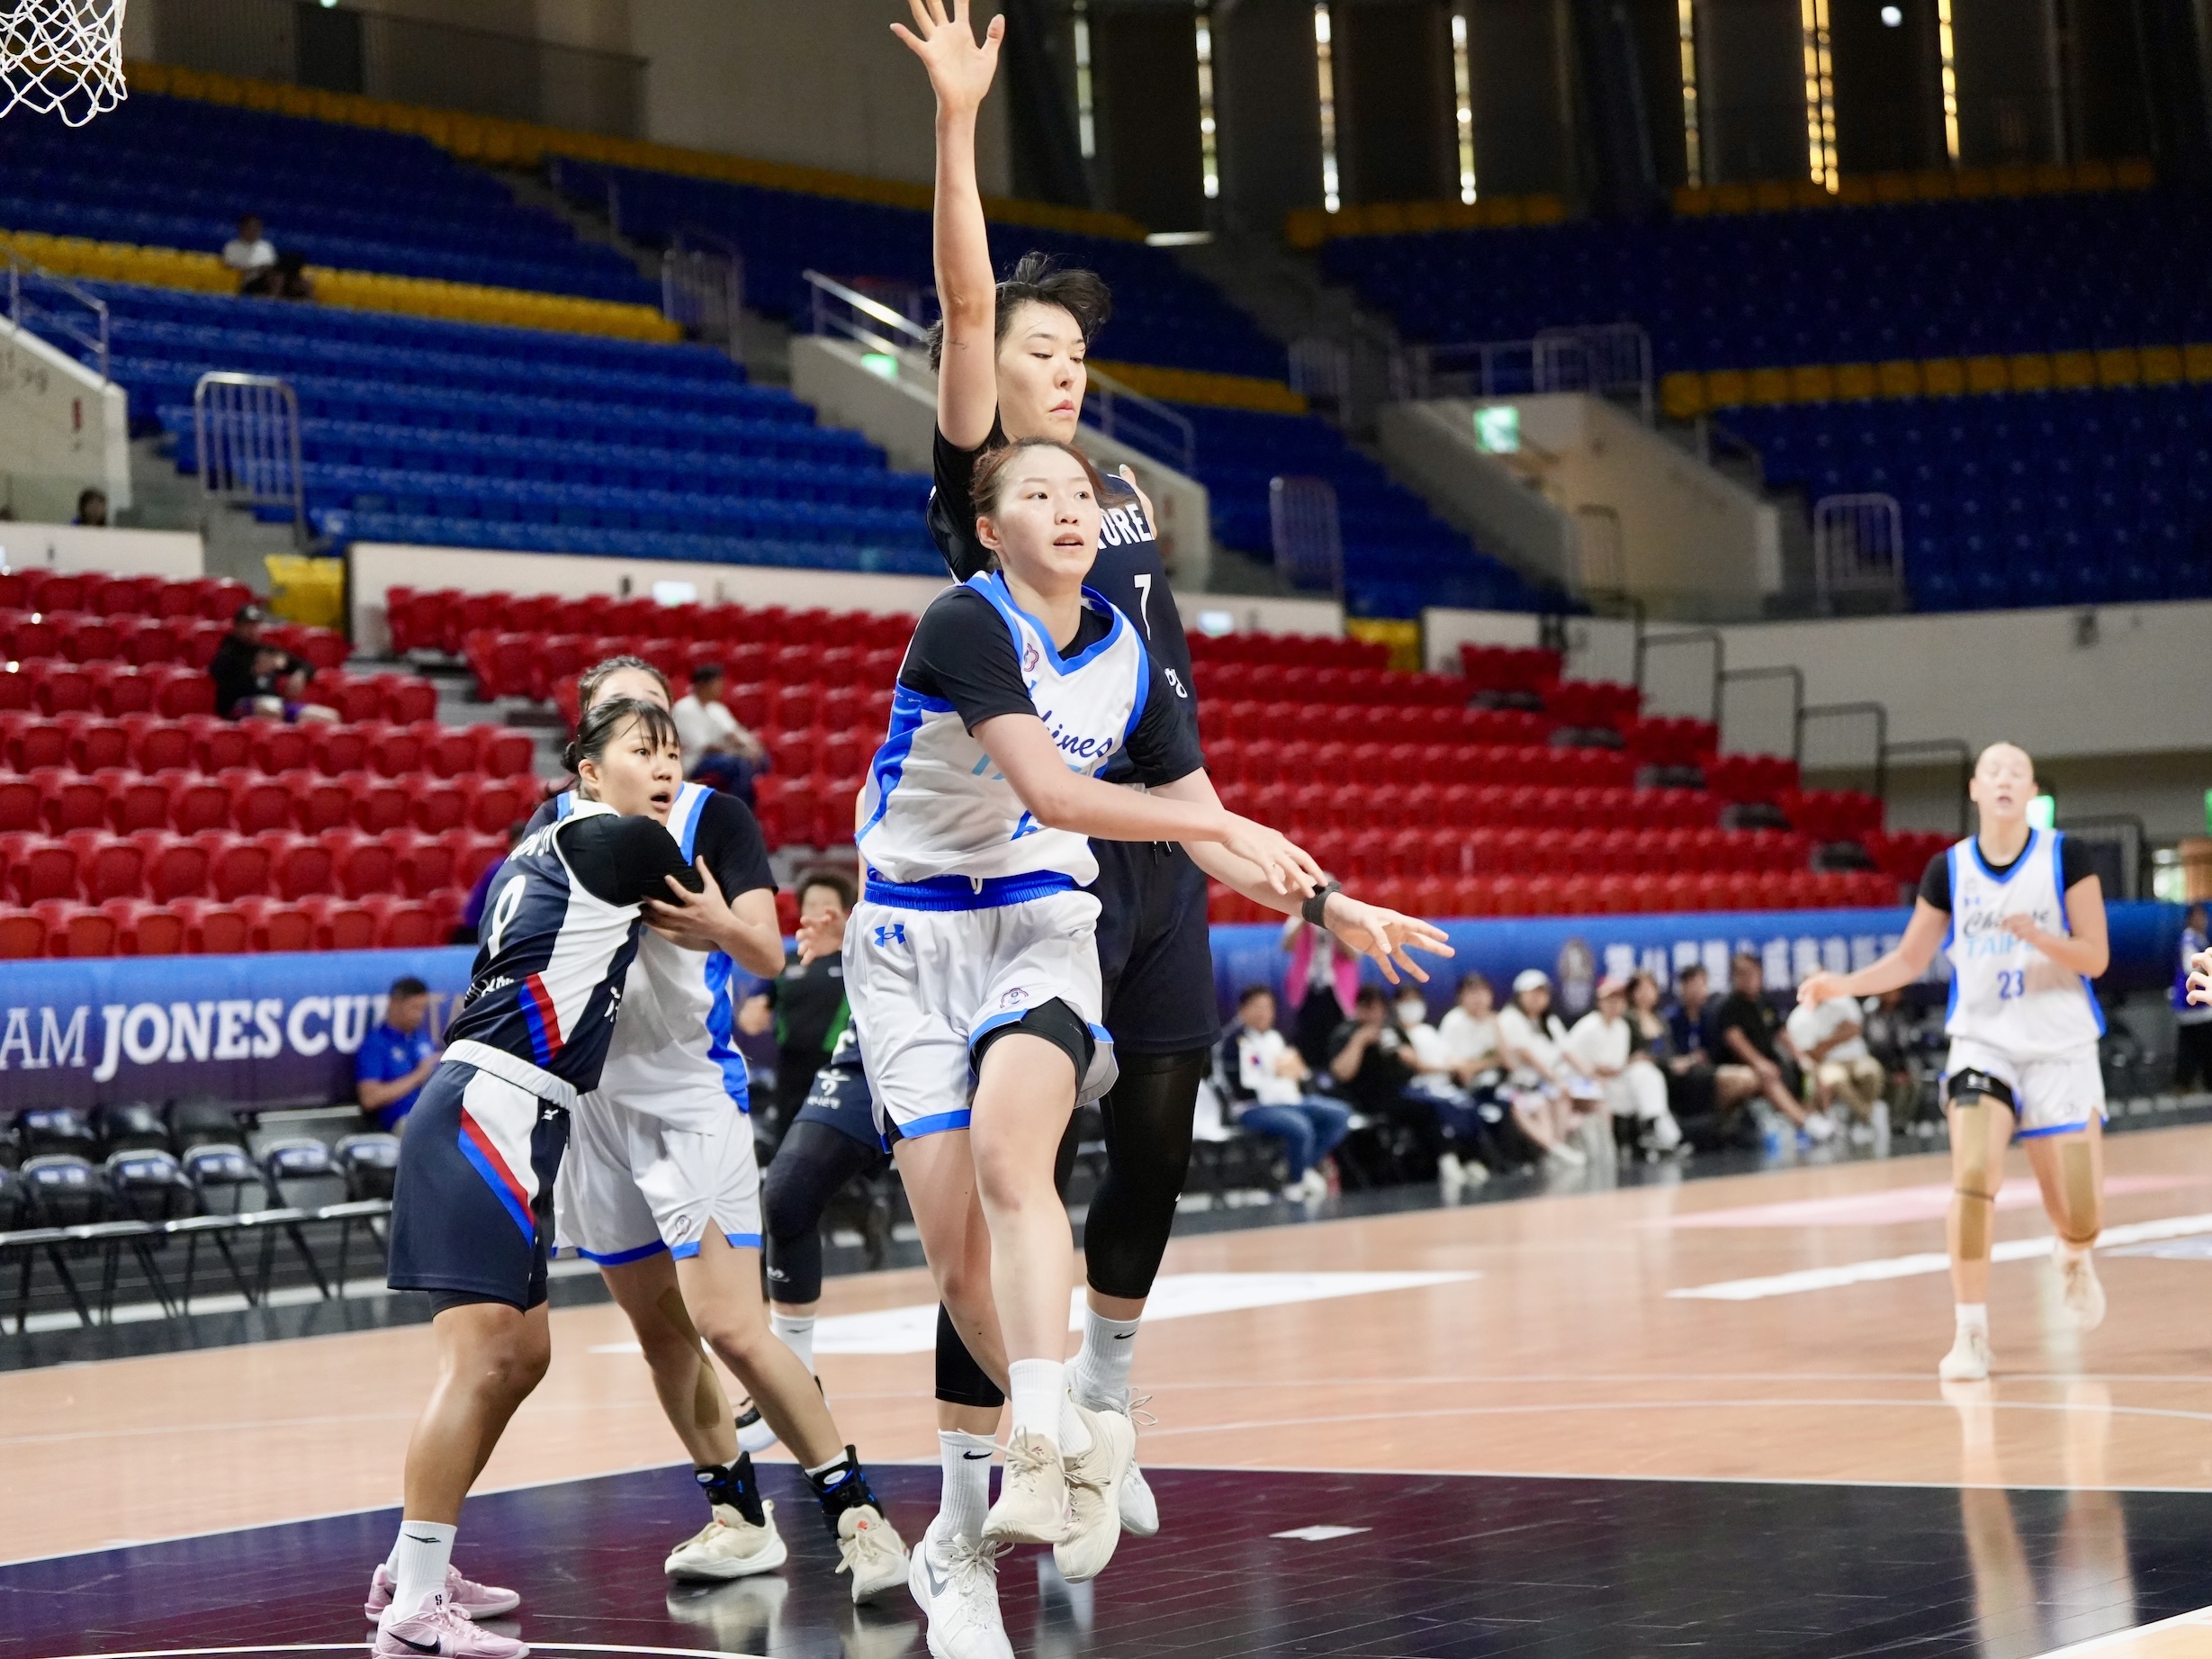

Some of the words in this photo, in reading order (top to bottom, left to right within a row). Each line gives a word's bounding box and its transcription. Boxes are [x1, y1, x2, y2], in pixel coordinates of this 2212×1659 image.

[1098, 504, 1155, 550] ORE
[1133, 573, 1152, 641] 7
[487, 874, 526, 960] 9
[1997, 969, 2025, 1002] 23
[93, 997, 284, 1083] JONES
